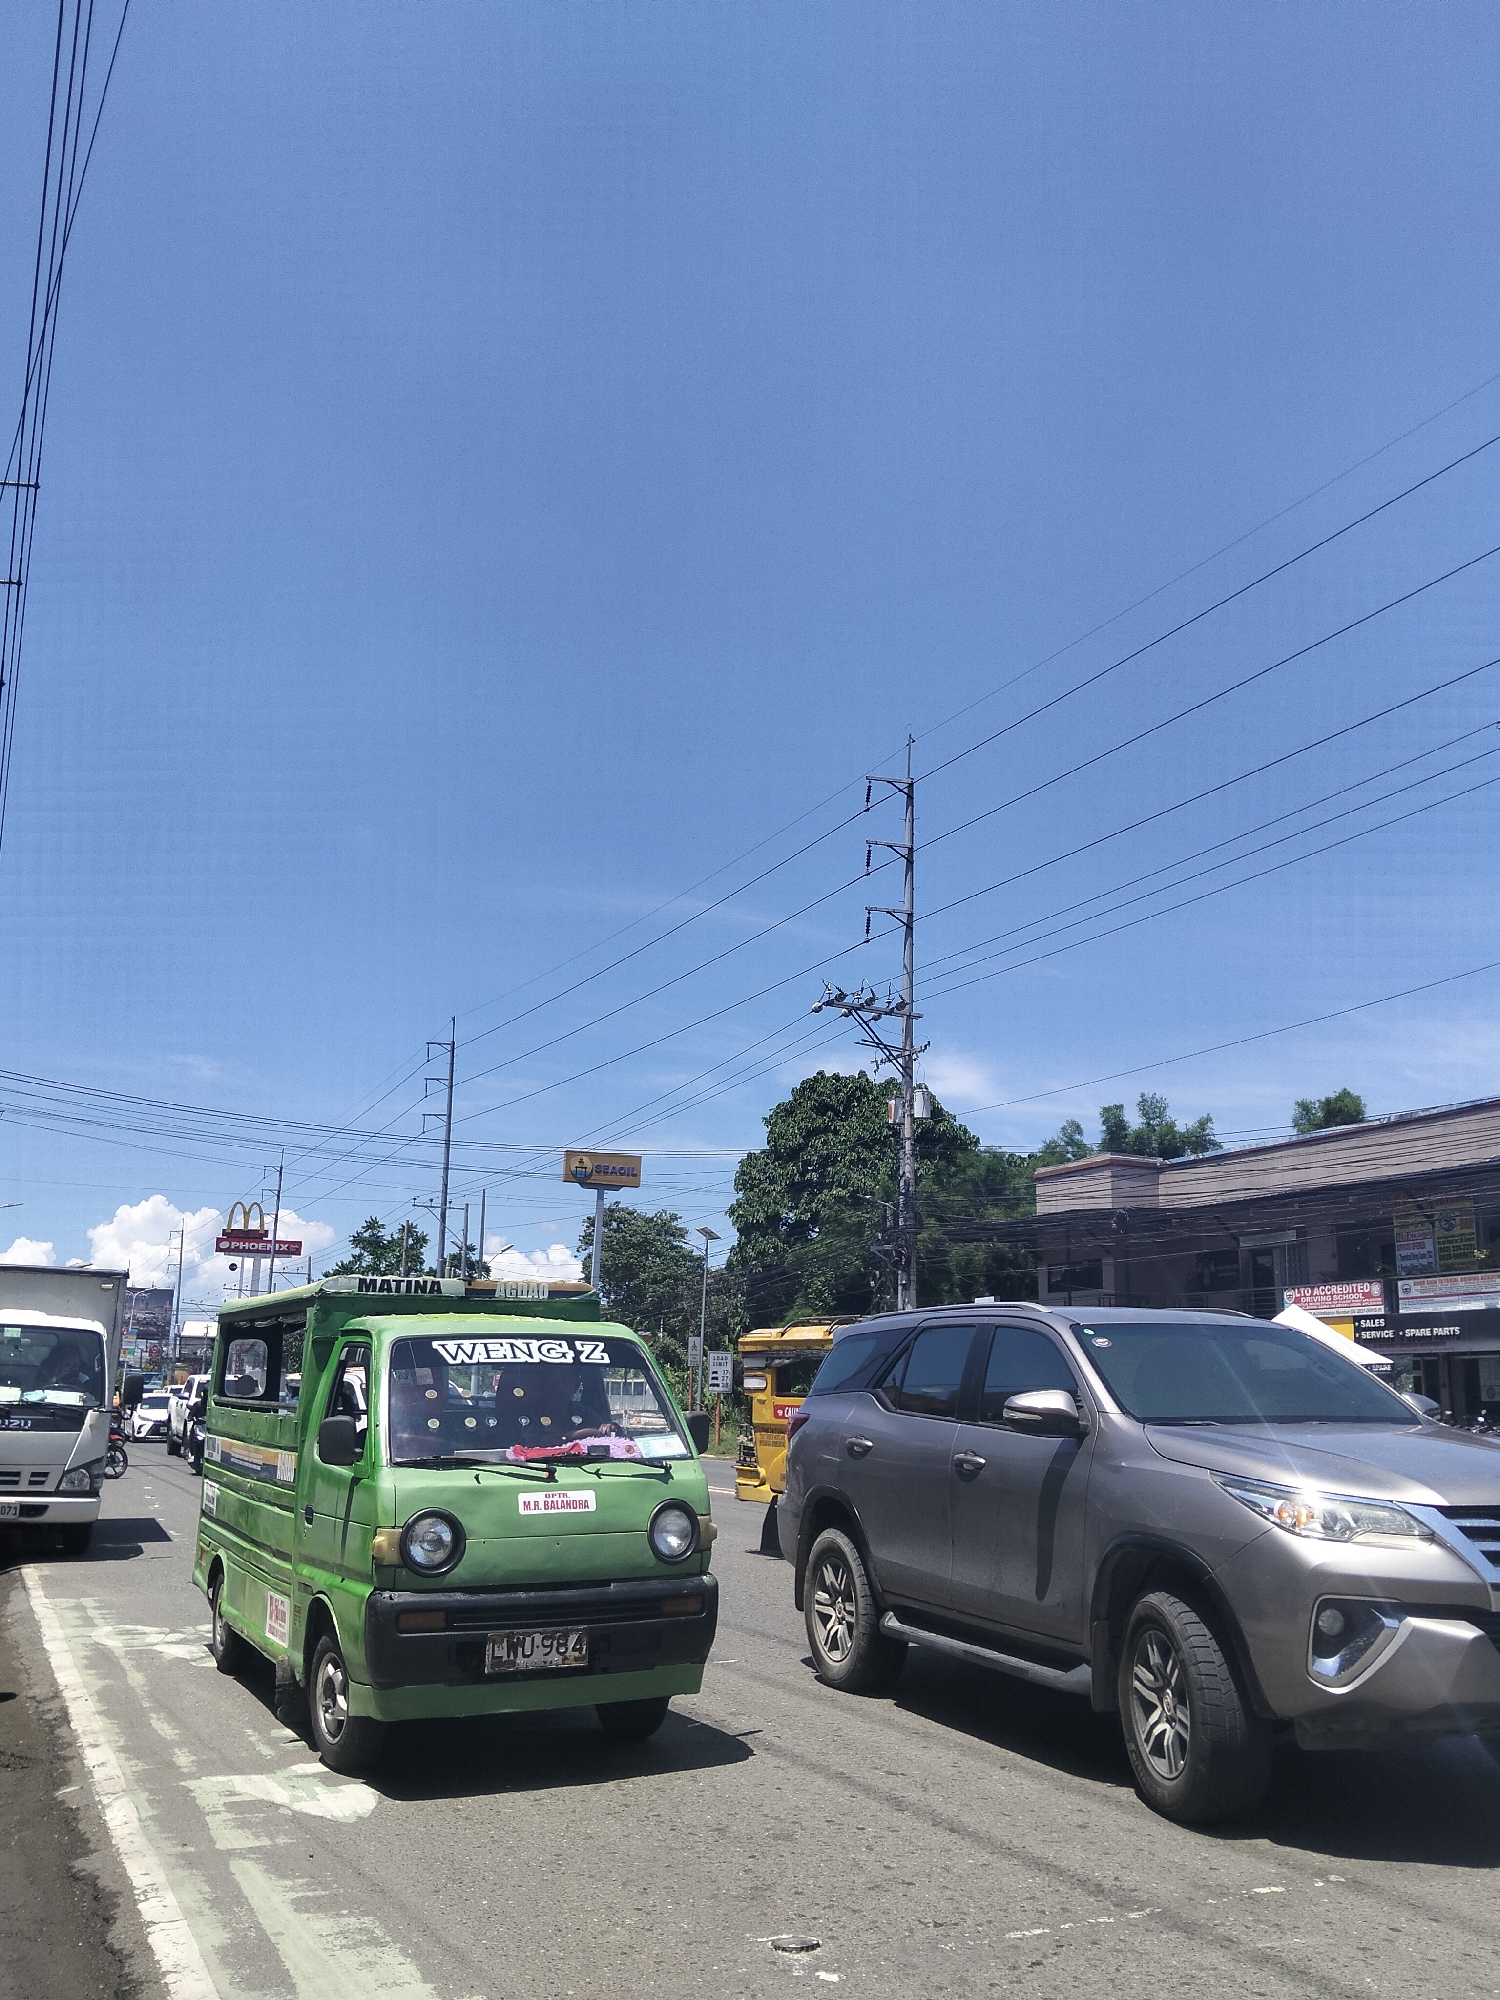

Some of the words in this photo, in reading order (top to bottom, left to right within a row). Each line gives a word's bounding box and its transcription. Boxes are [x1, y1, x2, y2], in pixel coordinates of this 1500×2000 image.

[594, 1163, 638, 1177] SEAOIL
[231, 1241, 289, 1251] PHOENIX
[358, 1278, 443, 1294] MATINA
[495, 1281, 549, 1299] AGDAO
[1295, 1287, 1311, 1297] LTO
[1313, 1283, 1370, 1296] ACCREDITED
[1301, 1295, 1331, 1303] DRIVING
[1333, 1293, 1364, 1302] SCHOOL
[1360, 1319, 1385, 1328] SALES
[1361, 1330, 1394, 1339] SERVICE
[1405, 1328, 1431, 1337] SPARE
[1433, 1327, 1460, 1336] PARTS
[432, 1339, 575, 1364] WENG
[575, 1341, 610, 1363] Z
[523, 1501, 542, 1511] M.R.
[544, 1500, 590, 1511] BALANDRA
